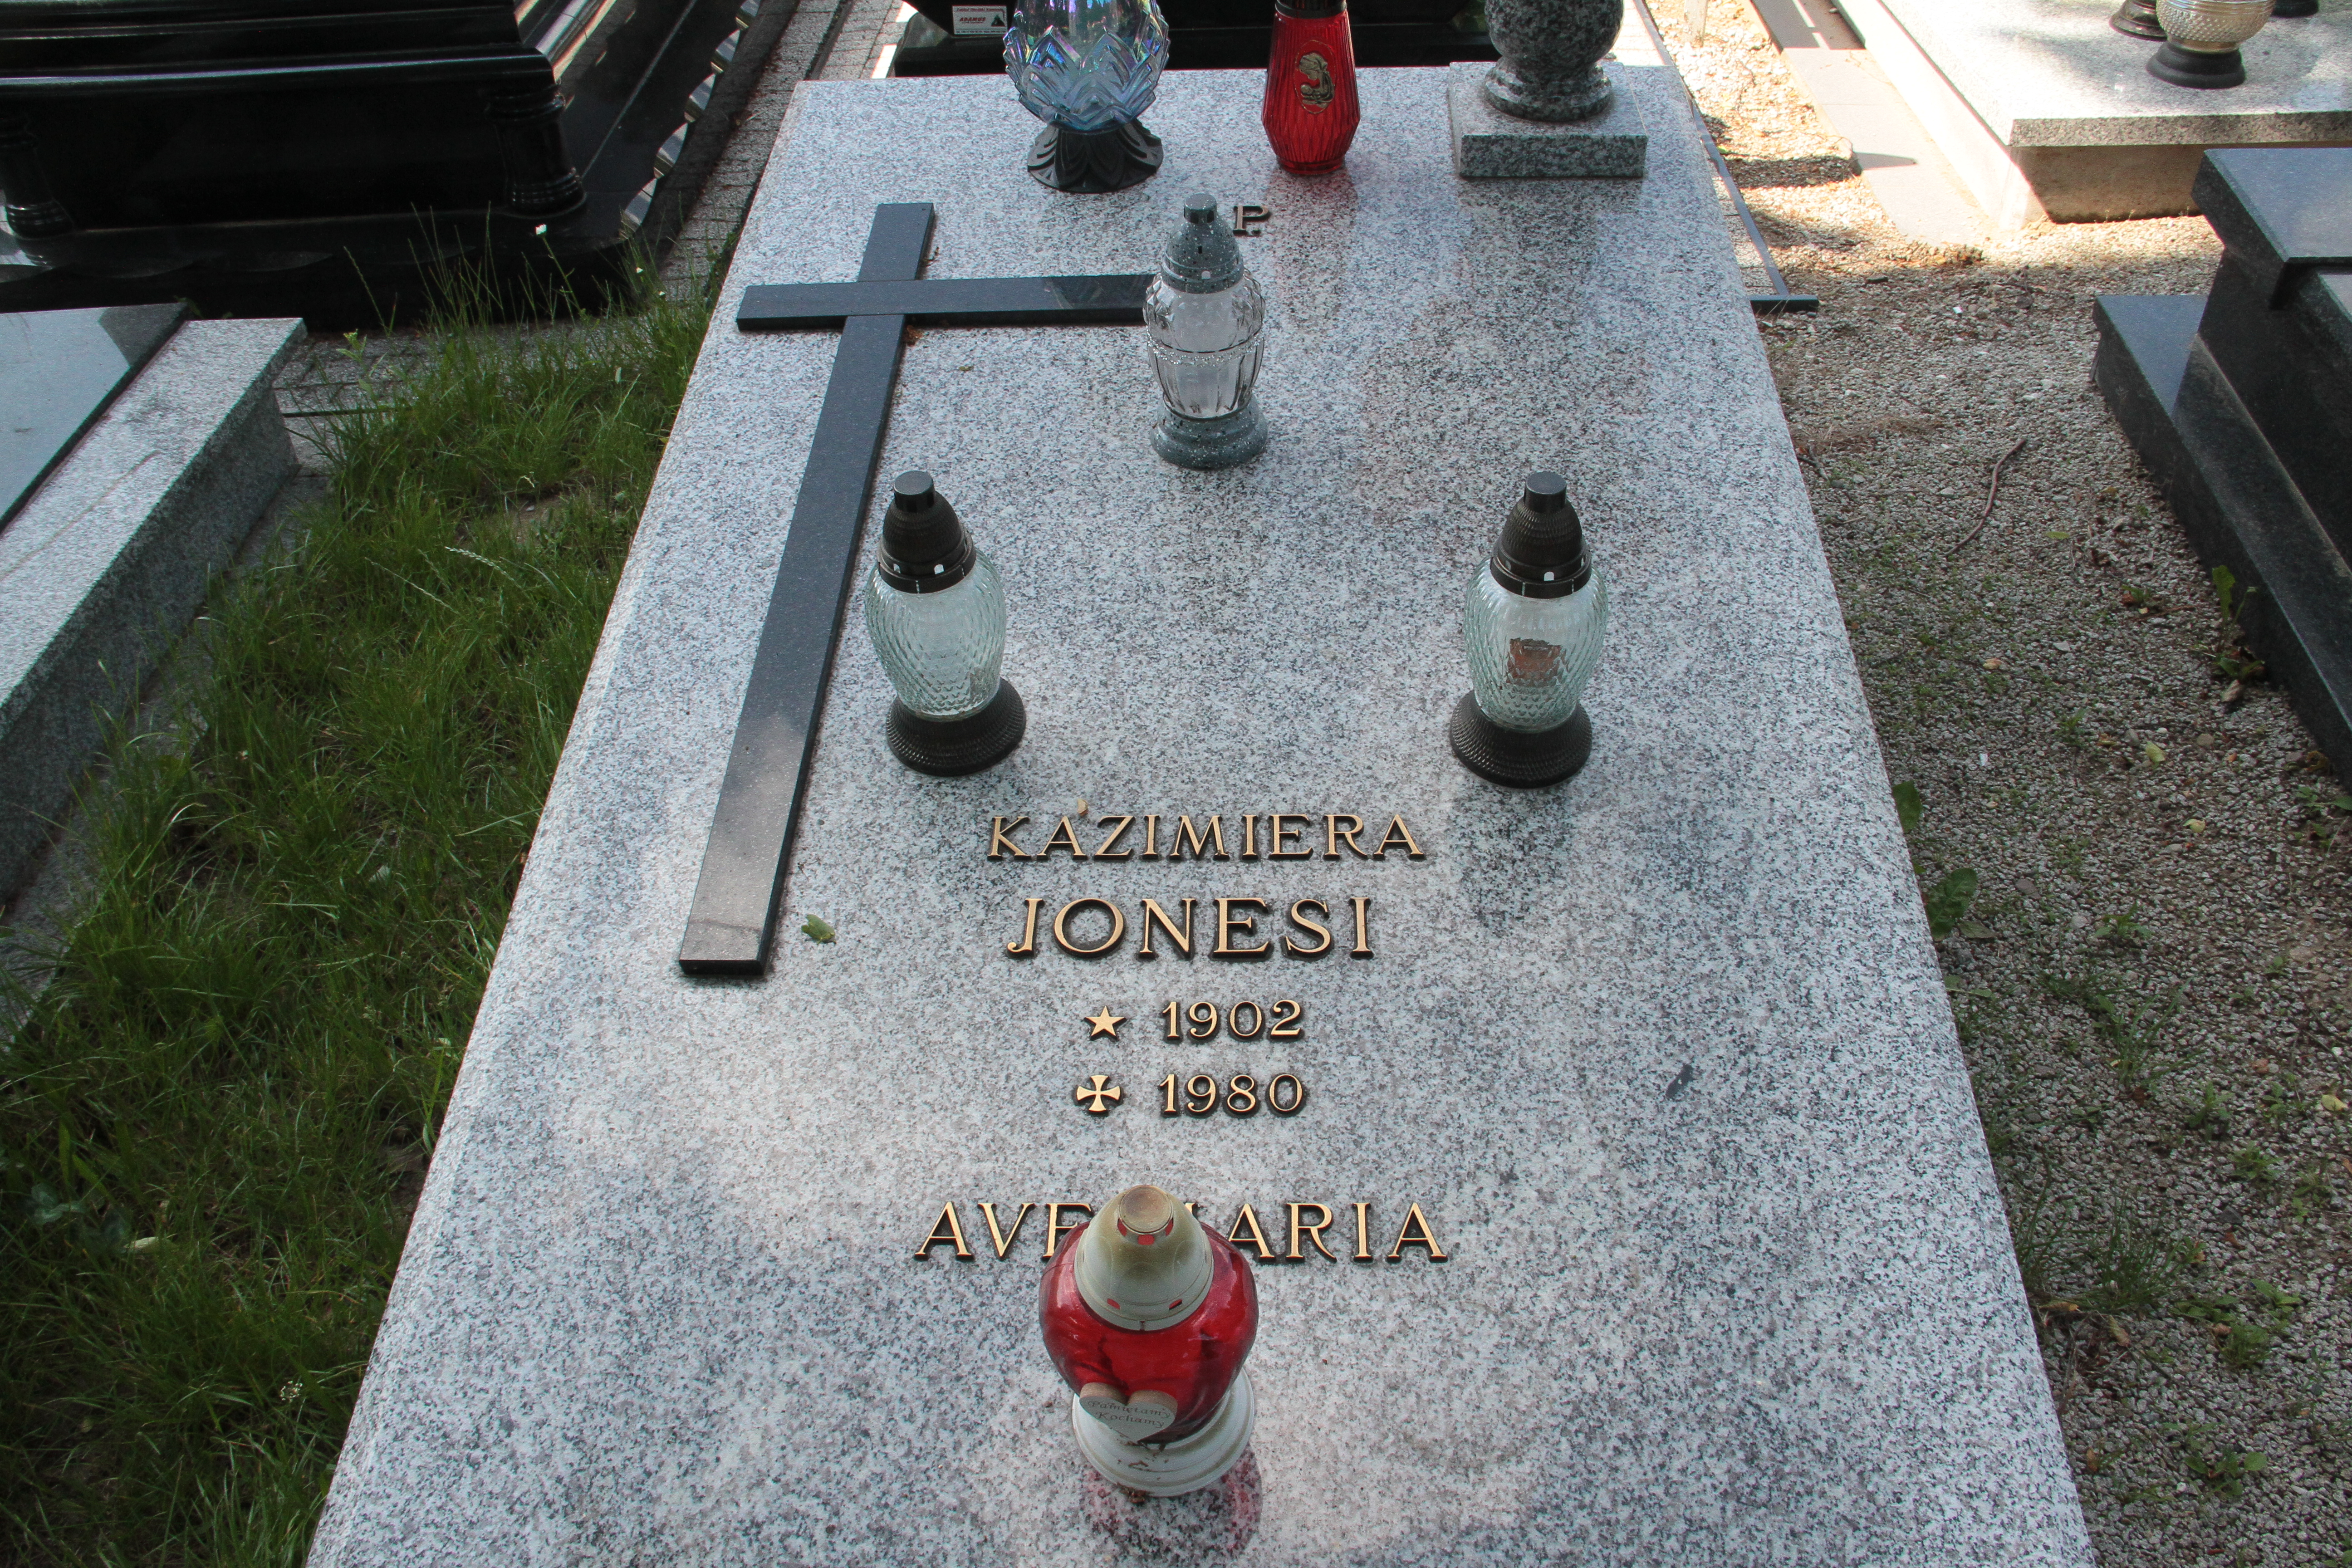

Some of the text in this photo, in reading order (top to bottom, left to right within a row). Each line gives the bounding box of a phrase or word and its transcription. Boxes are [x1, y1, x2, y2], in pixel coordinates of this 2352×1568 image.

[987, 813, 1426, 861] KAZIMIERA
[1006, 897, 1373, 959] JONESI
[1161, 999, 1303, 1040] 1902
[1158, 1073, 1304, 1114] 1980
[1183, 1202, 1449, 1263] ARIA
